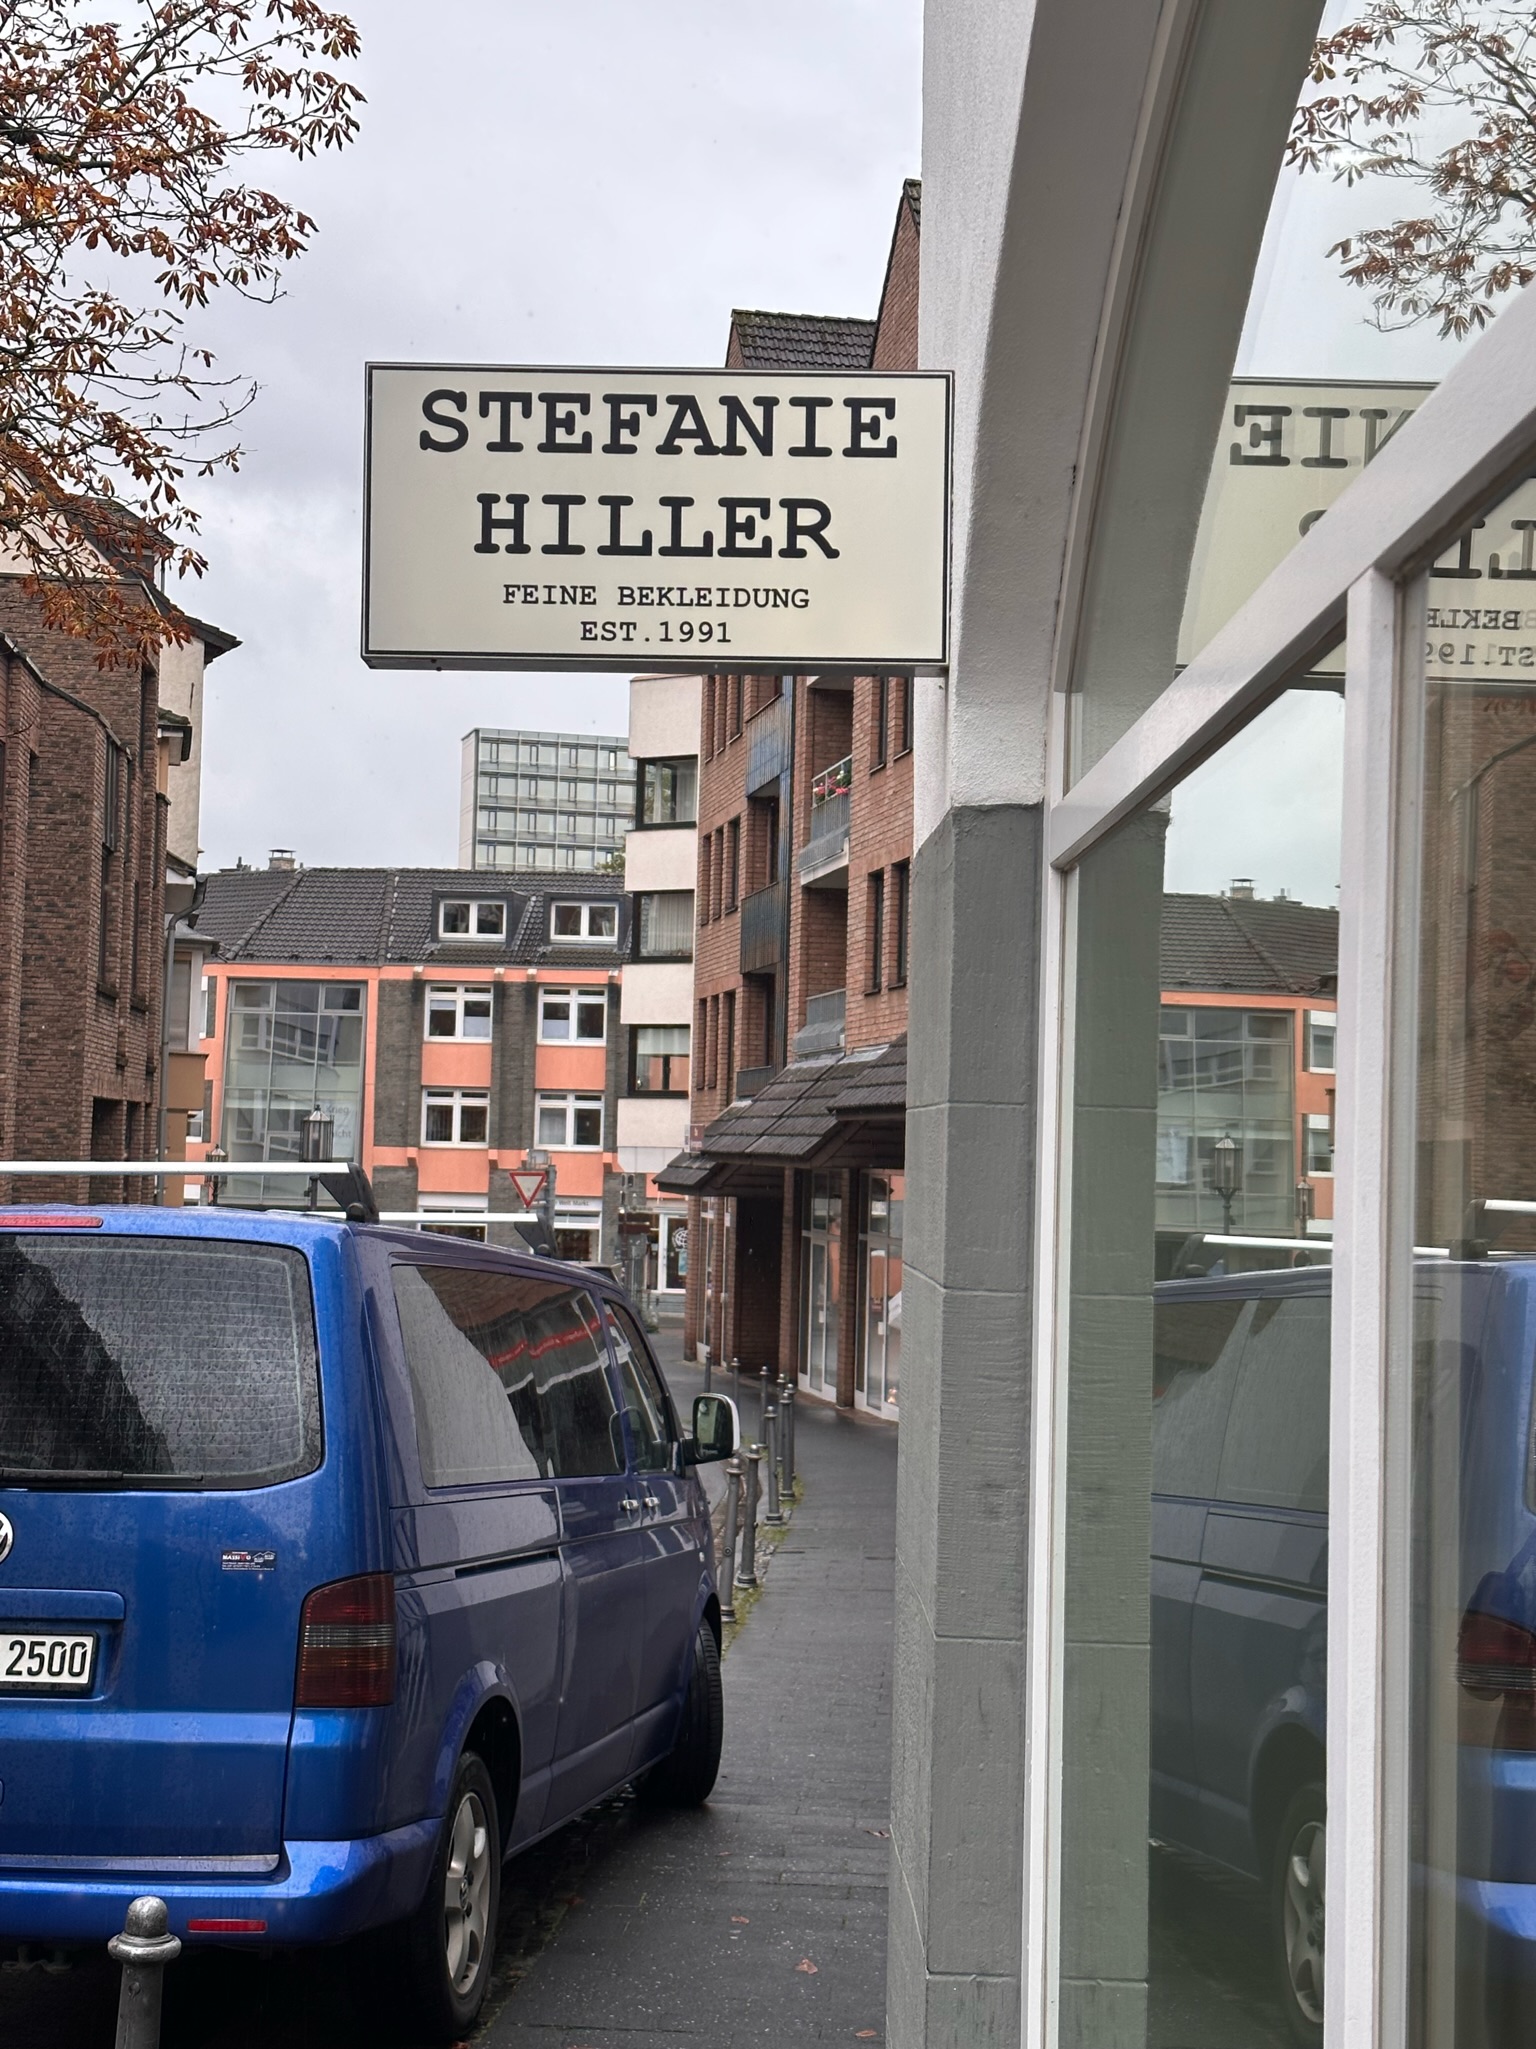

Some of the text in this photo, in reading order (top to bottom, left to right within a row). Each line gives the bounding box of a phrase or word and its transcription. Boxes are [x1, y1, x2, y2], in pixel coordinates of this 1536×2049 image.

[420, 389, 898, 458] STEFANIE
[474, 493, 840, 559] HILLER
[503, 584, 810, 609] FEINE BEKLEIDUNG
[580, 621, 732, 644] EST.1991
[5, 1639, 88, 1677] 2500
